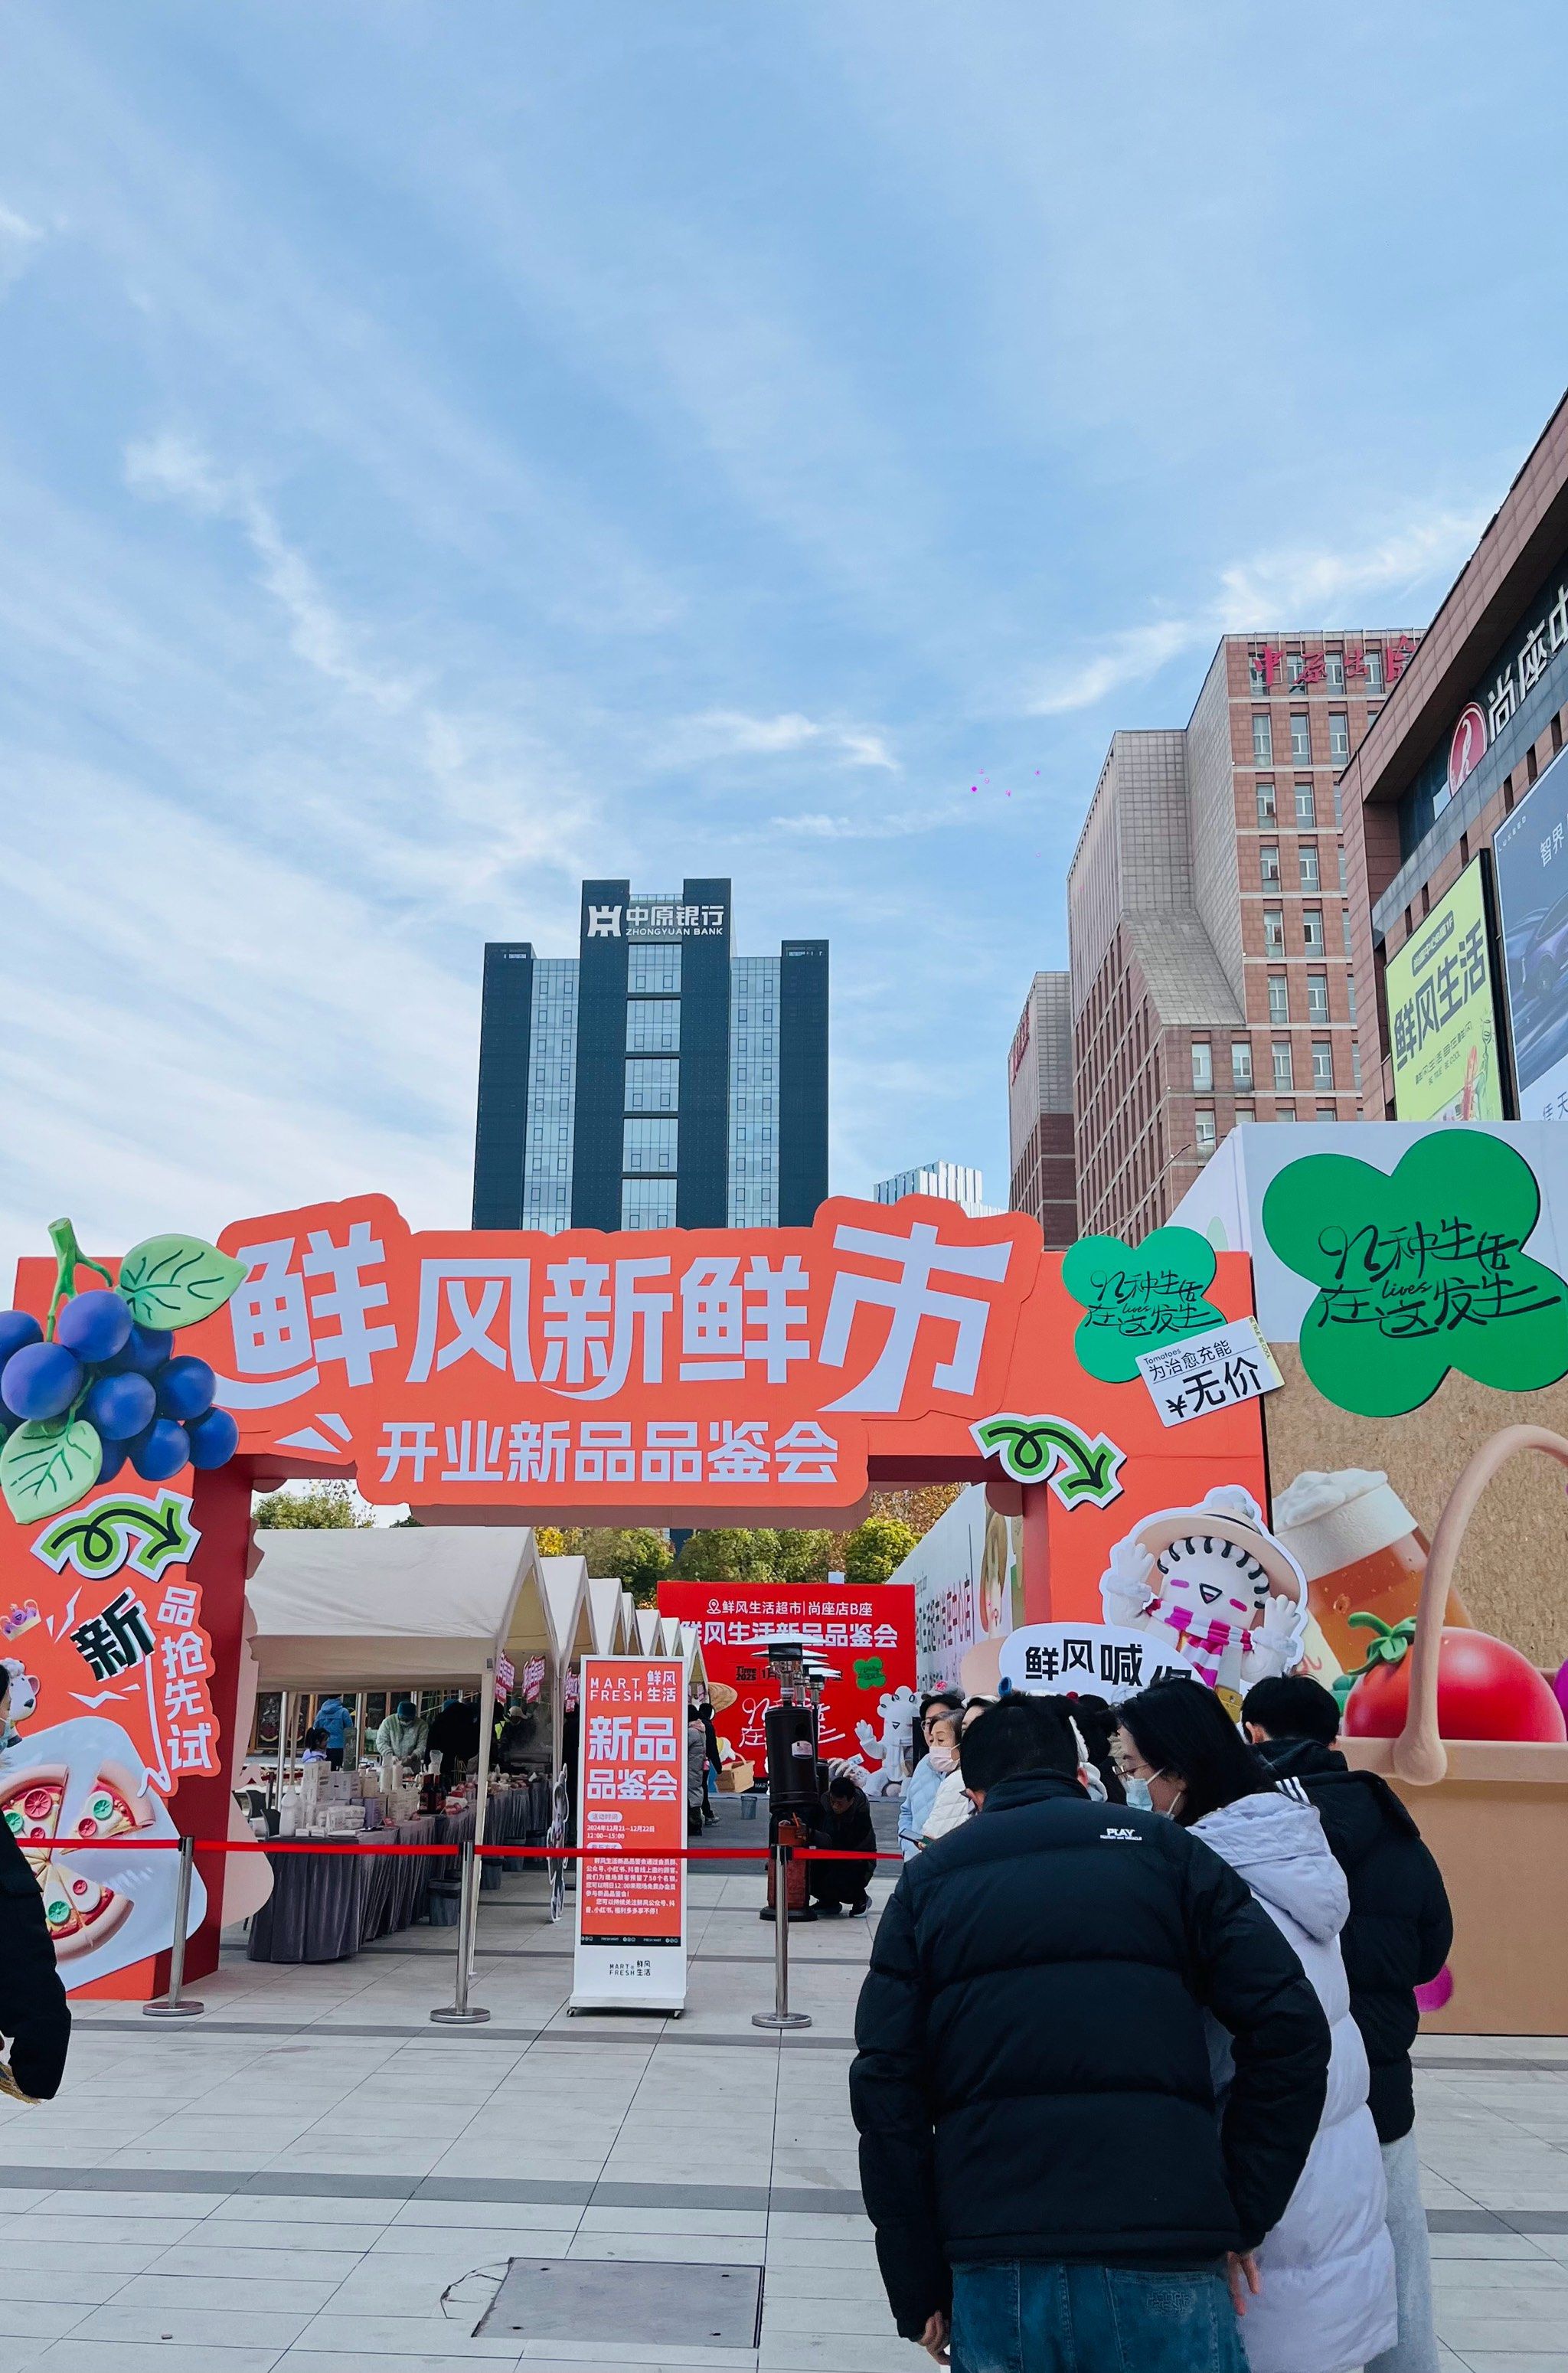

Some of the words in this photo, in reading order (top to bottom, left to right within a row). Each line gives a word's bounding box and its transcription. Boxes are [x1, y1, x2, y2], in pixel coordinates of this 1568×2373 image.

[626, 906, 724, 927] 中原银行
[1393, 918, 1486, 1072] 鲜风生活
[215, 1220, 1014, 1413] 鲜风新鲜市
[1084, 1303, 1223, 1337] 在这发生
[1318, 1273, 1562, 1339] 在这发生
[1143, 1348, 1181, 1365] Tomatoes
[1149, 1339, 1232, 1381] 为治愈充能
[1165, 1357, 1262, 1418] ¥无价
[377, 1420, 838, 1484] 开业新品品鉴会
[722, 1600, 802, 1615] 鲜风生活超市
[808, 1601, 873, 1616] 尚座店B座
[70, 1588, 156, 1682] 新
[157, 1585, 213, 1770] 品抢先试
[590, 1677, 640, 1689] MART
[647, 1670, 676, 1686] 鲜风
[736, 1672, 756, 1681] 2025
[737, 1665, 756, 1674] Time
[590, 1690, 642, 1701] FRESH
[647, 1687, 676, 1702] 生活
[588, 1715, 677, 1762] 新品
[587, 1769, 678, 1801] 品鉴会
[1106, 1828, 1135, 1836] PLAY
